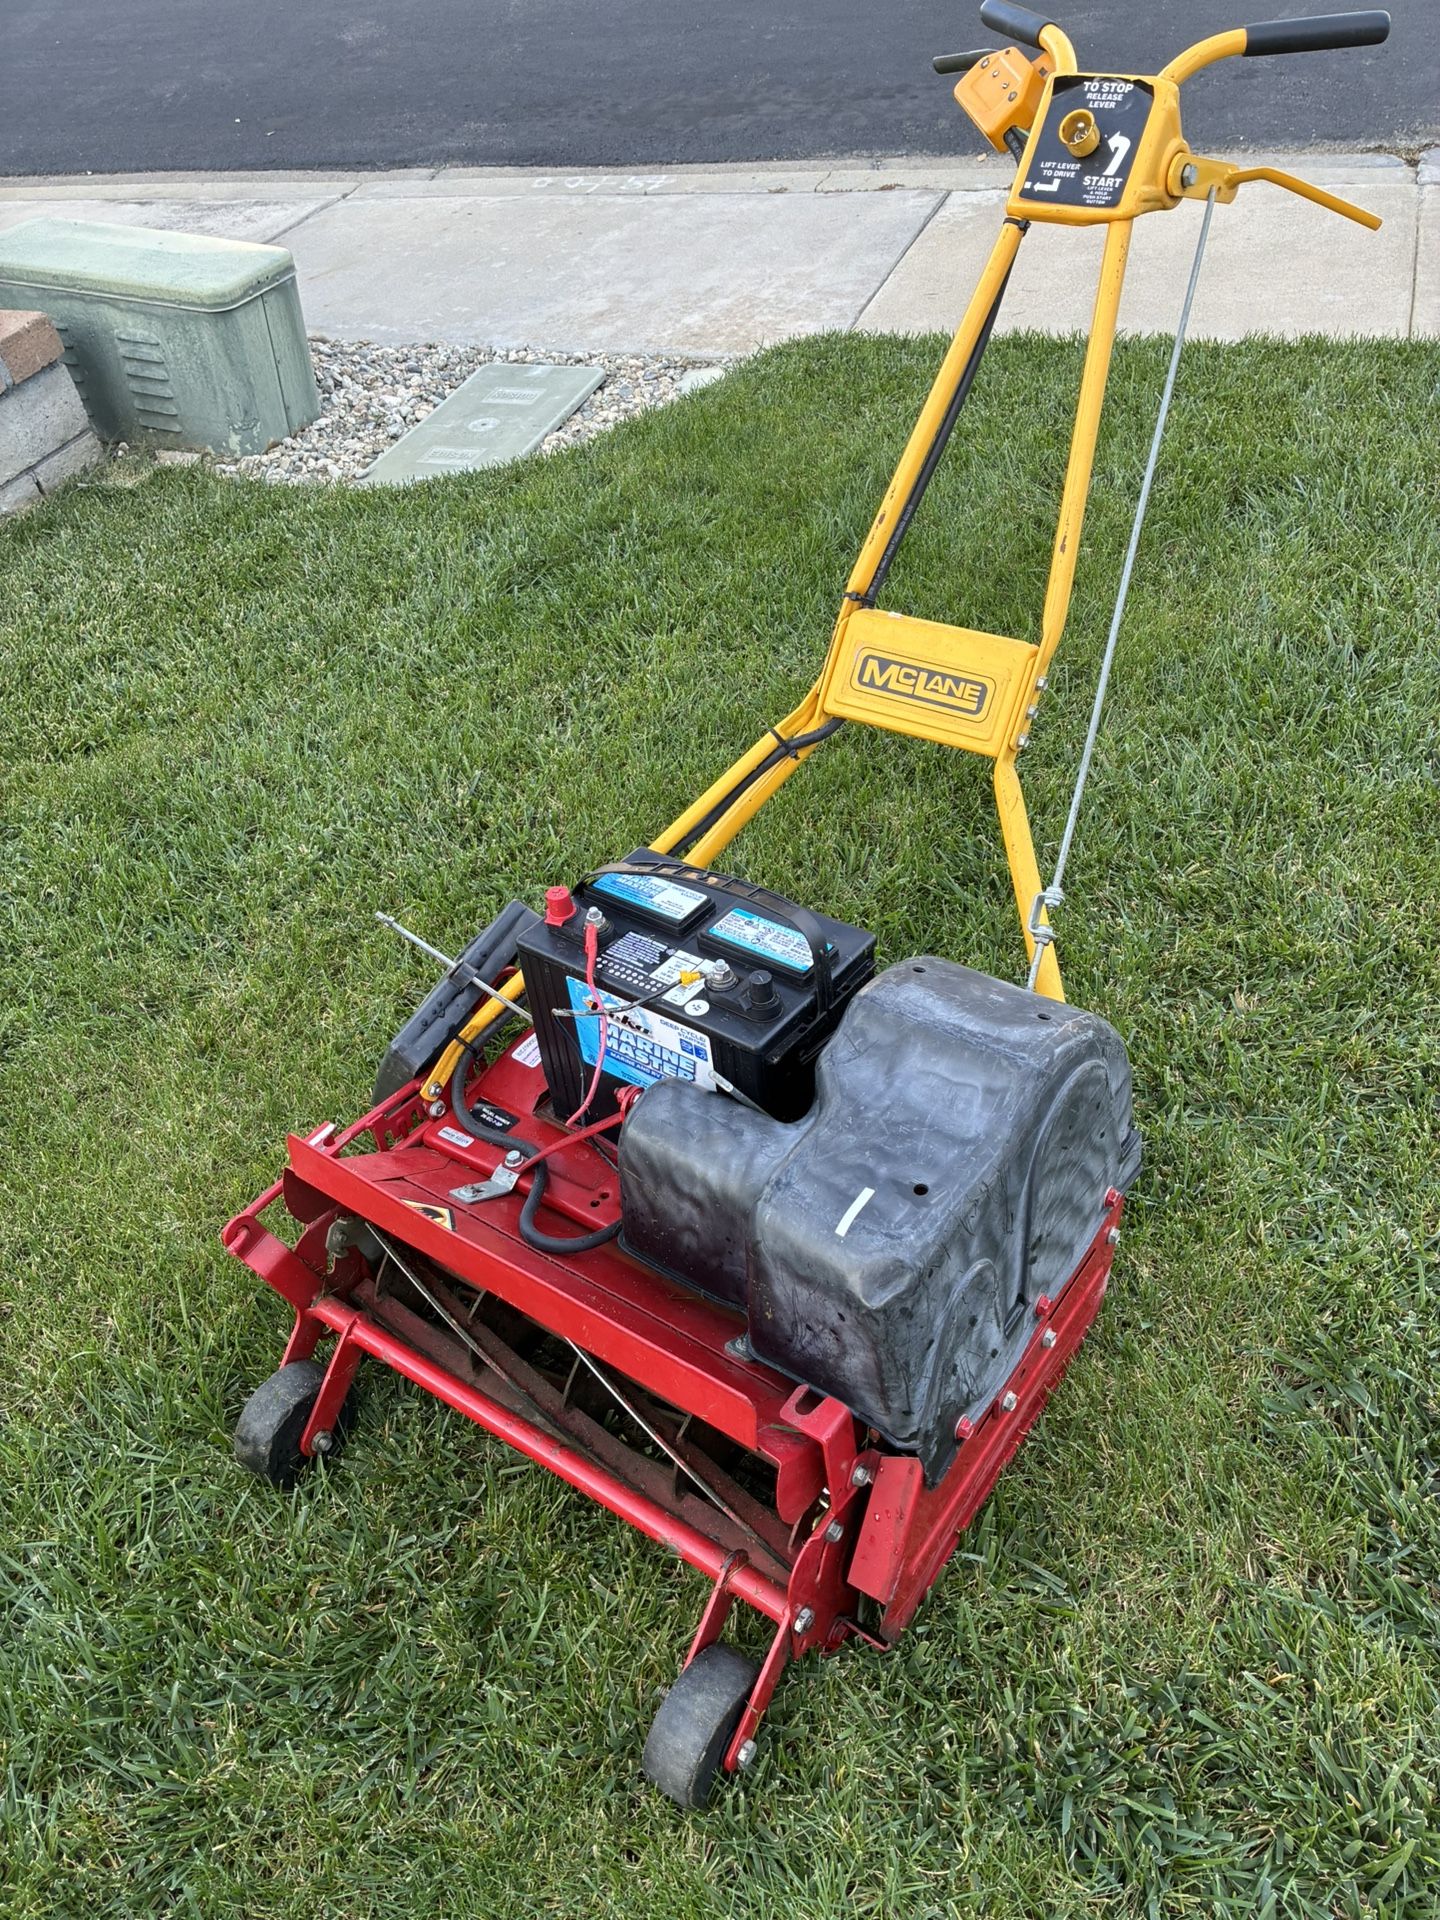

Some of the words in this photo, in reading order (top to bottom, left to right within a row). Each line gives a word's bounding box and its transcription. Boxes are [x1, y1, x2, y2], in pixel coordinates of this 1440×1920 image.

[1083, 82, 1099, 92] TO
[1101, 83, 1134, 93] STOP
[1086, 93, 1124, 101] RELEASE
[1088, 101, 1116, 109] LEVER
[1040, 161, 1056, 169] LIFT
[1057, 162, 1082, 170] LEVER
[1082, 175, 1123, 188] START
[660, 1019, 680, 1031] DEEP
[599, 1017, 696, 1075] MARINE
[599, 1033, 696, 1082] MASTER
[610, 1051, 635, 1068] MARINE
